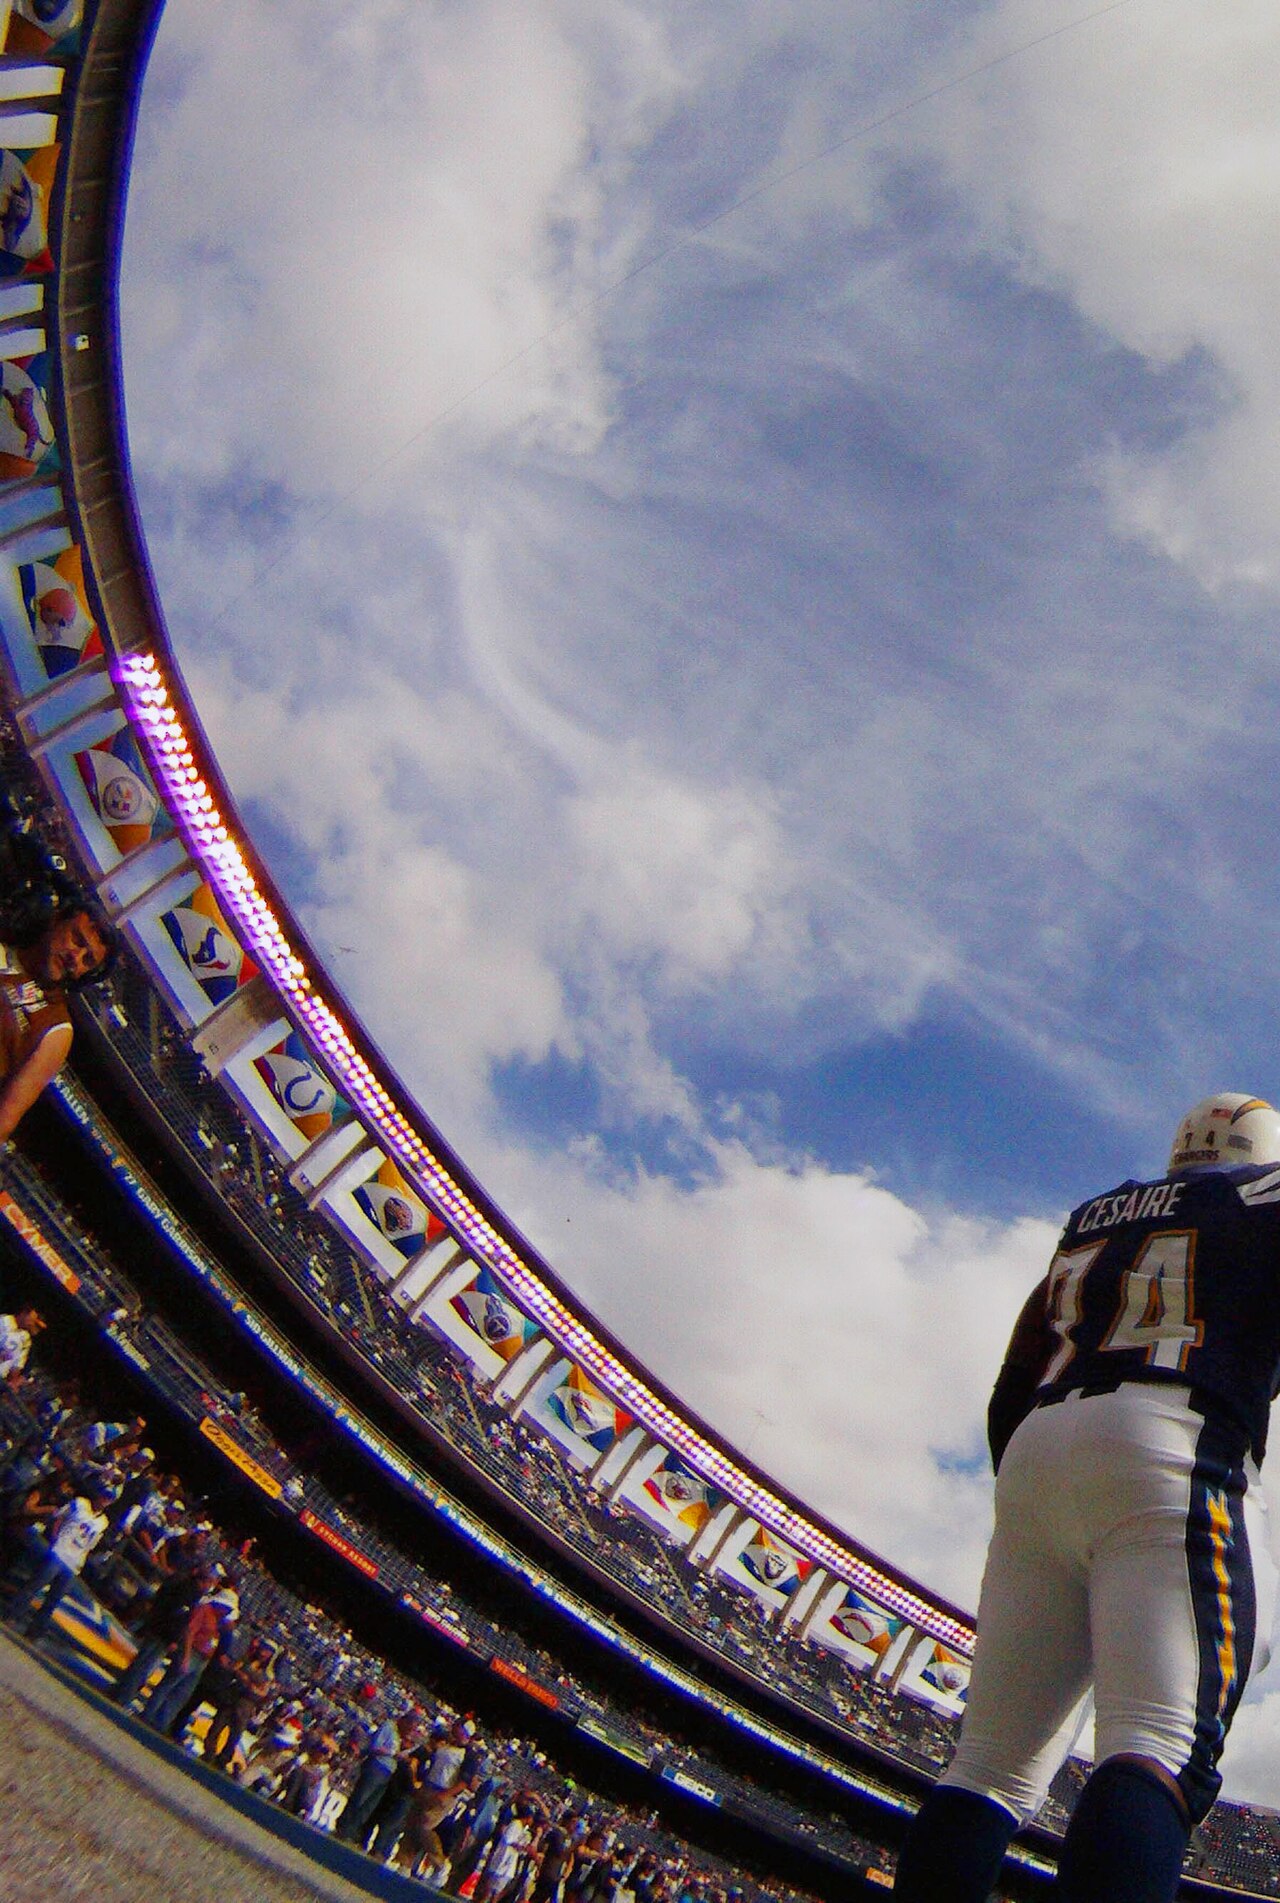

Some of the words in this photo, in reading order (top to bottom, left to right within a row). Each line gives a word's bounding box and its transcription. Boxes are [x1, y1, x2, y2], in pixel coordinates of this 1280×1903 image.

[134, 1186, 163, 1219] GARY
[159, 1216, 209, 1275] GARRISON
[1077, 1182, 1188, 1233] CESAIRE
[4, 1204, 74, 1285] CYMER
[1038, 1228, 1206, 1387] 74
[242, 1313, 262, 1334] SID
[258, 1330, 302, 1375] GILLMAN
[494, 1658, 527, 1687] WELLS
[526, 1681, 559, 1708] FARGO
[674, 1772, 716, 1800] GEICO
